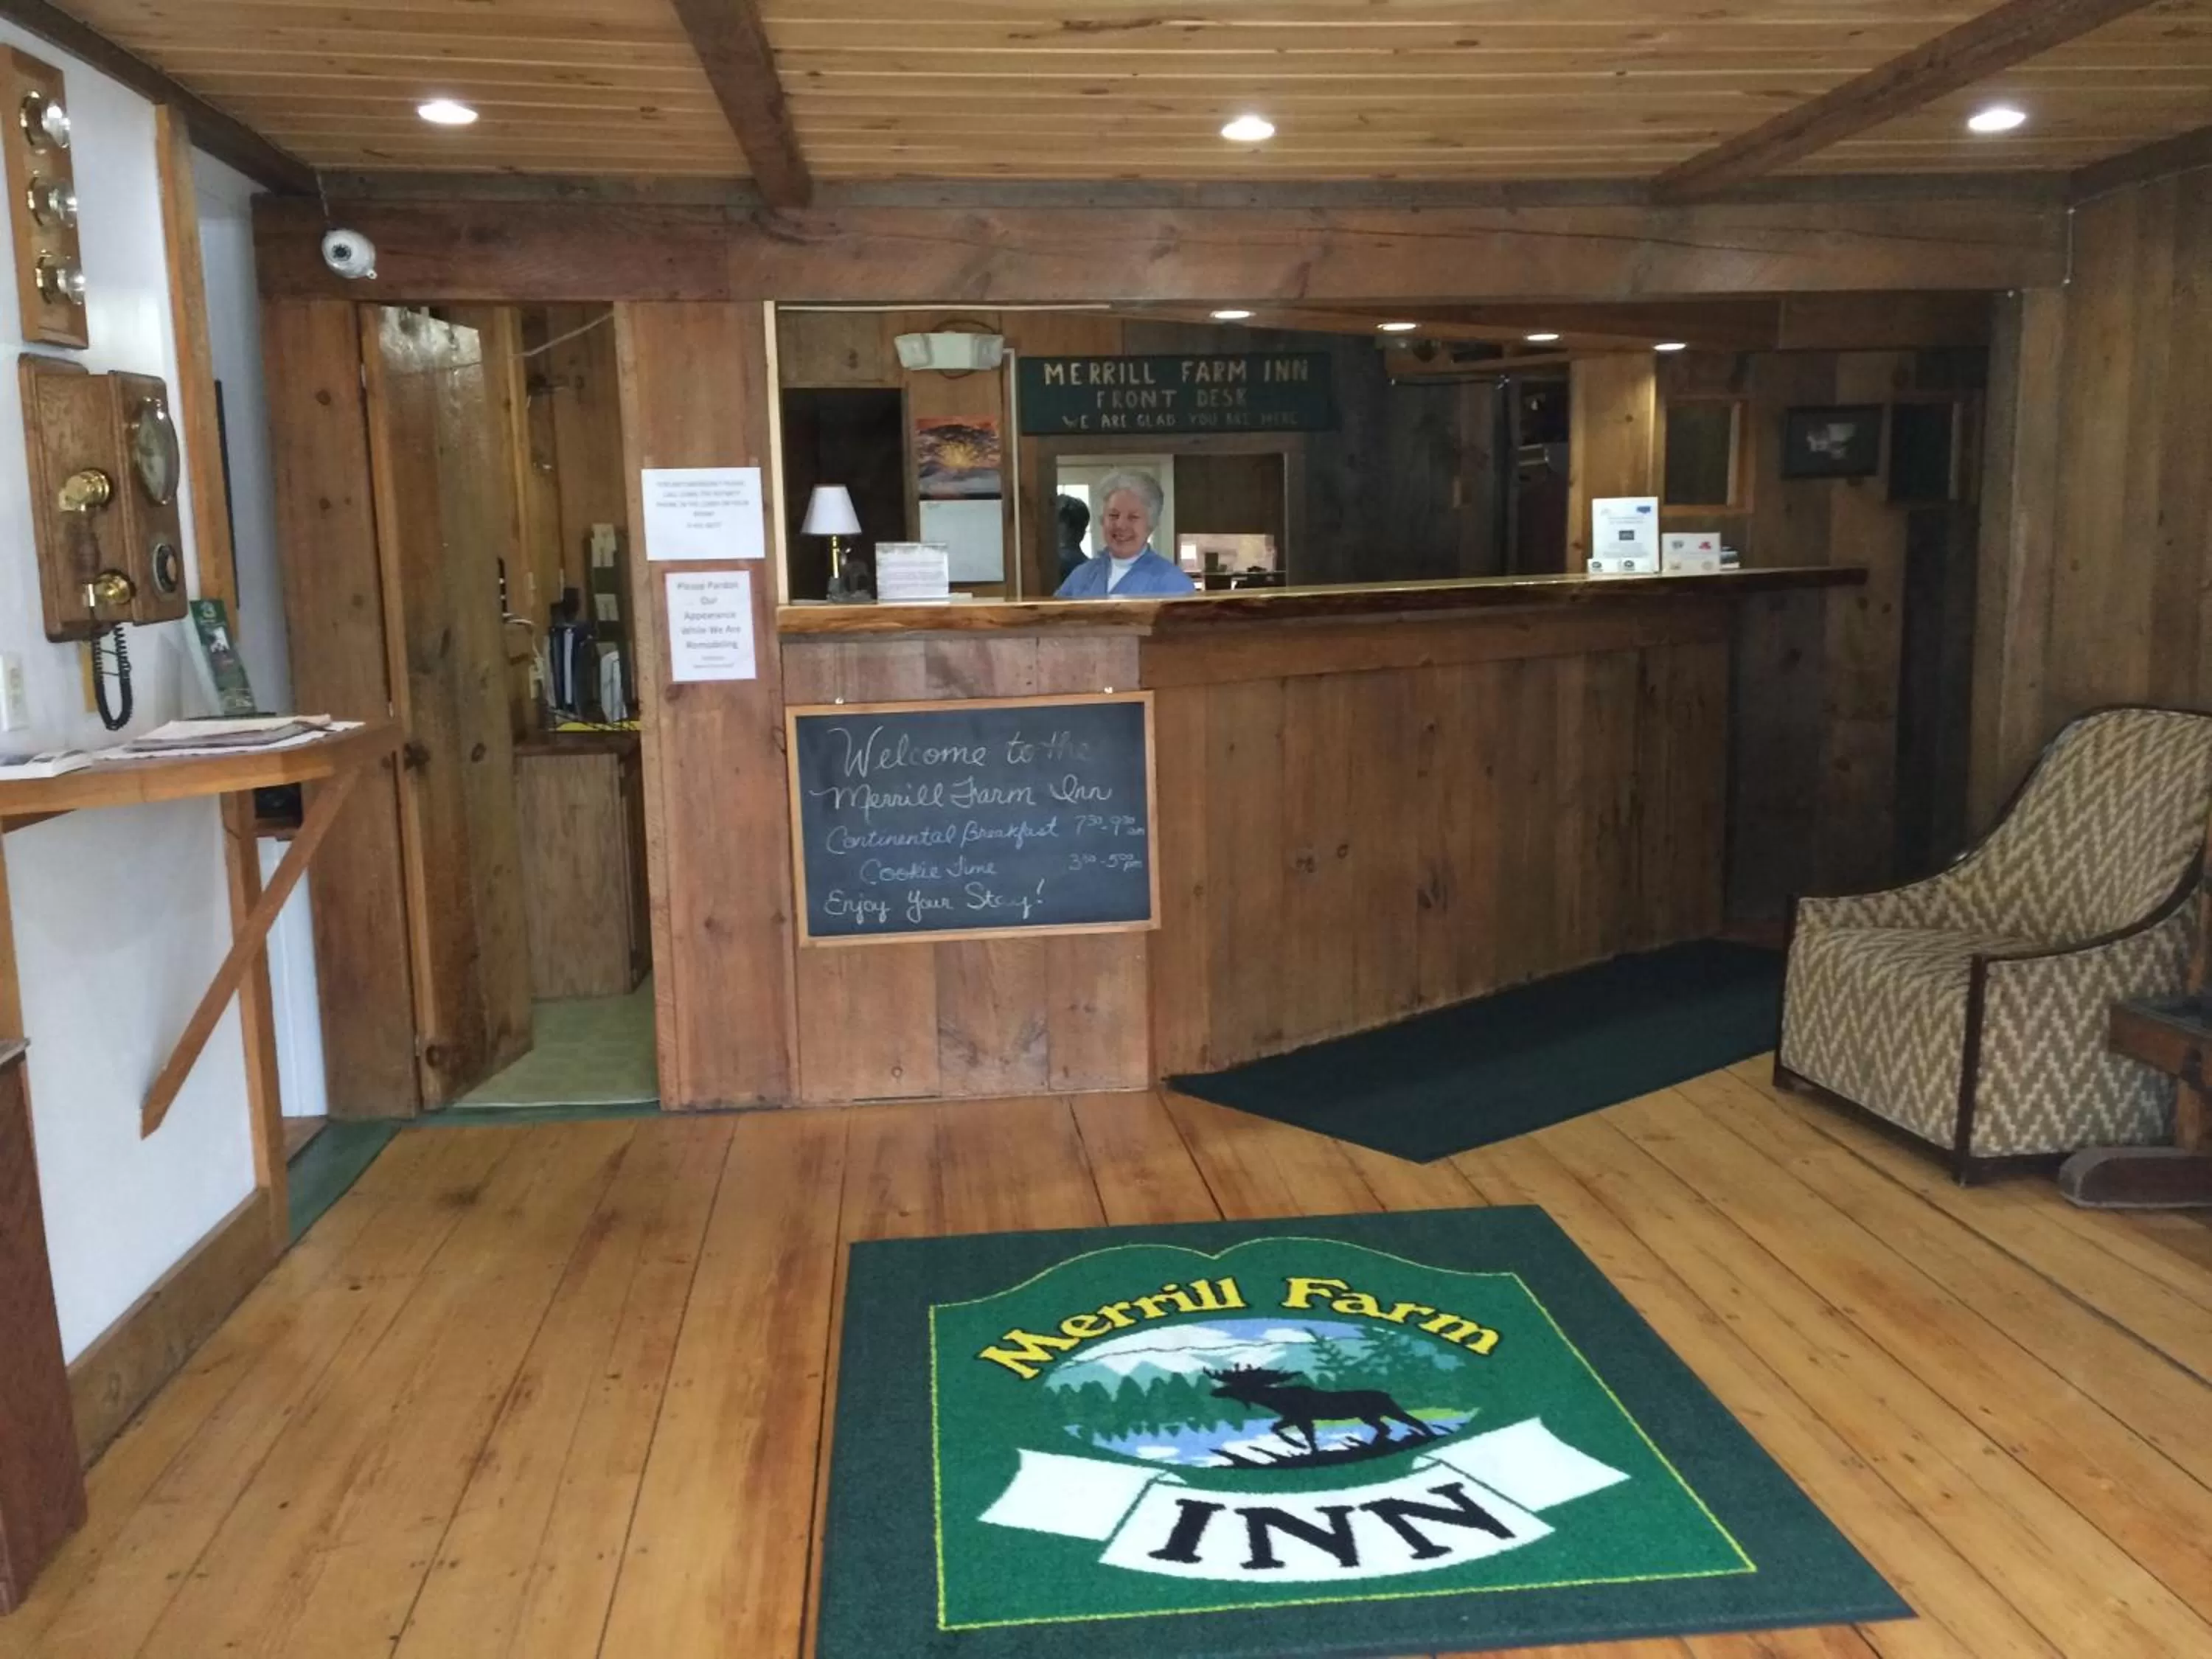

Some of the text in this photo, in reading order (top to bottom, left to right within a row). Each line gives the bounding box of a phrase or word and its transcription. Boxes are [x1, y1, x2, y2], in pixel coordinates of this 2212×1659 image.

[1043, 359, 1309, 386] MERRILL FARM INN
[1096, 388, 1248, 409] FRONT DESK
[1062, 416, 1088, 429] WE
[1101, 414, 1127, 428] ARE
[1137, 414, 1177, 427] GLAD
[1189, 412, 1218, 425] YOU
[827, 726, 1090, 778] Welcome to the
[809, 774, 1113, 825] Merrill Farm Inn
[826, 823, 956, 854] Continental
[960, 815, 1059, 850] Breakfast
[860, 858, 942, 885] Cookie
[946, 855, 998, 878] Time
[824, 889, 890, 925] Enjoy
[907, 890, 954, 922] Your
[973, 1276, 1505, 1380] Merrill Farm
[1148, 1481, 1517, 1570] INN
